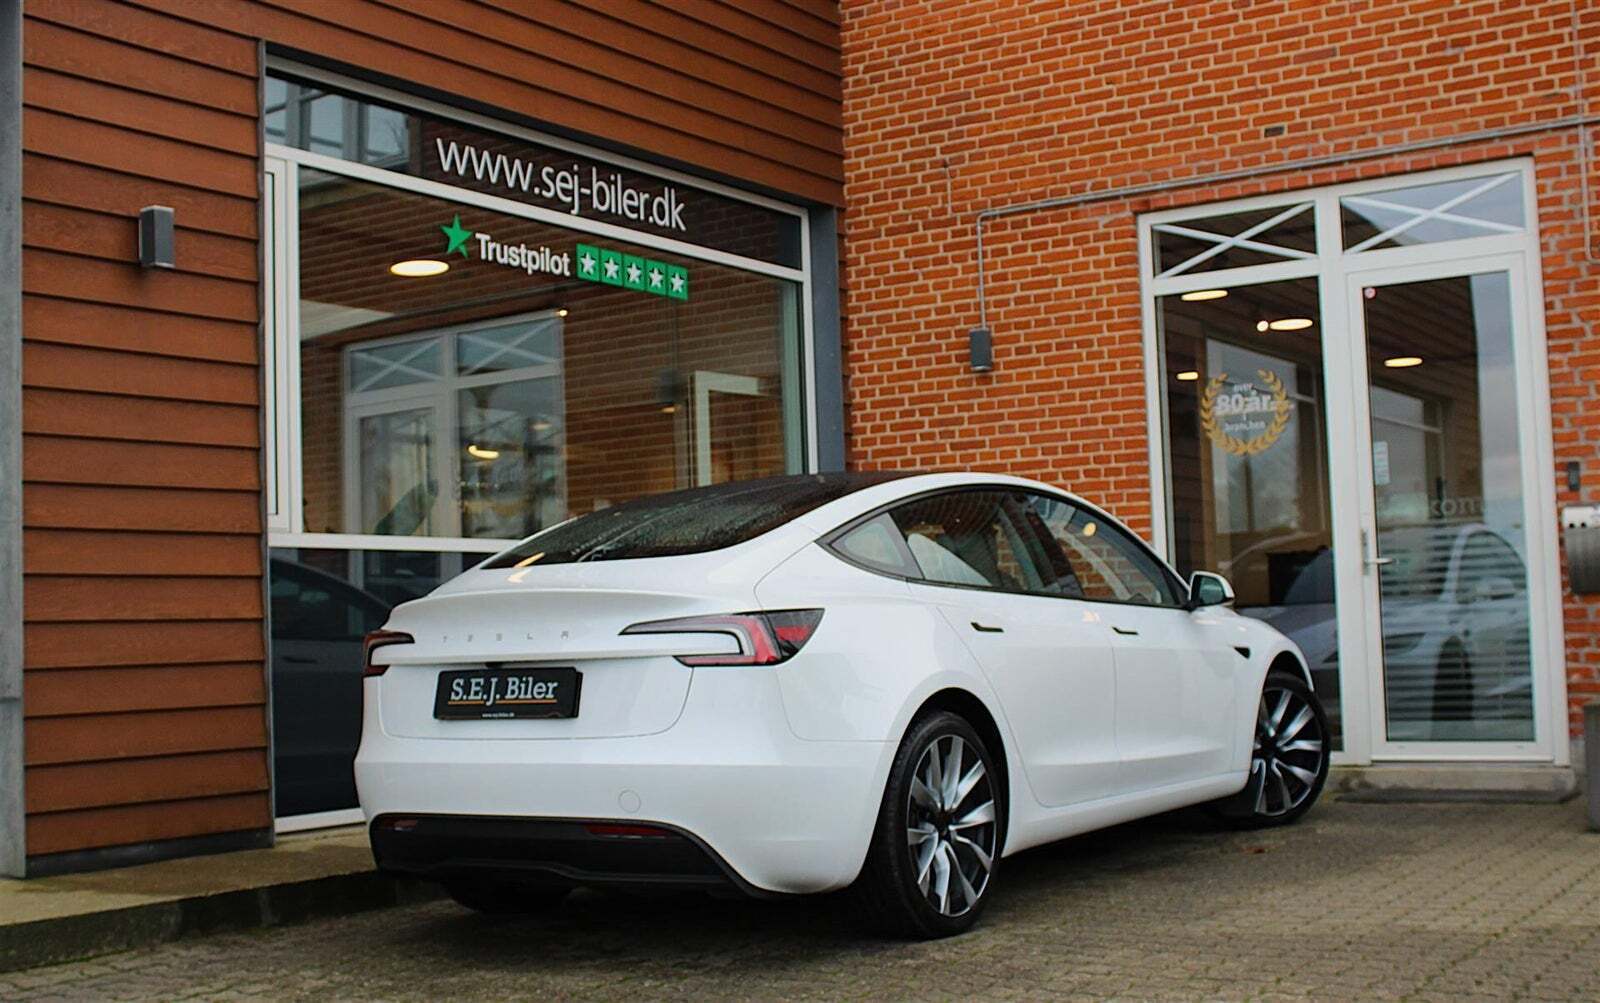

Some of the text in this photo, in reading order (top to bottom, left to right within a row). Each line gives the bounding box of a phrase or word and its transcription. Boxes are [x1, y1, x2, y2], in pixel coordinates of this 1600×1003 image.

[436, 137, 686, 231] www.sej-biler.dk
[475, 233, 571, 277] Trustpilot
[451, 676, 558, 706] S.E.J. Biler
